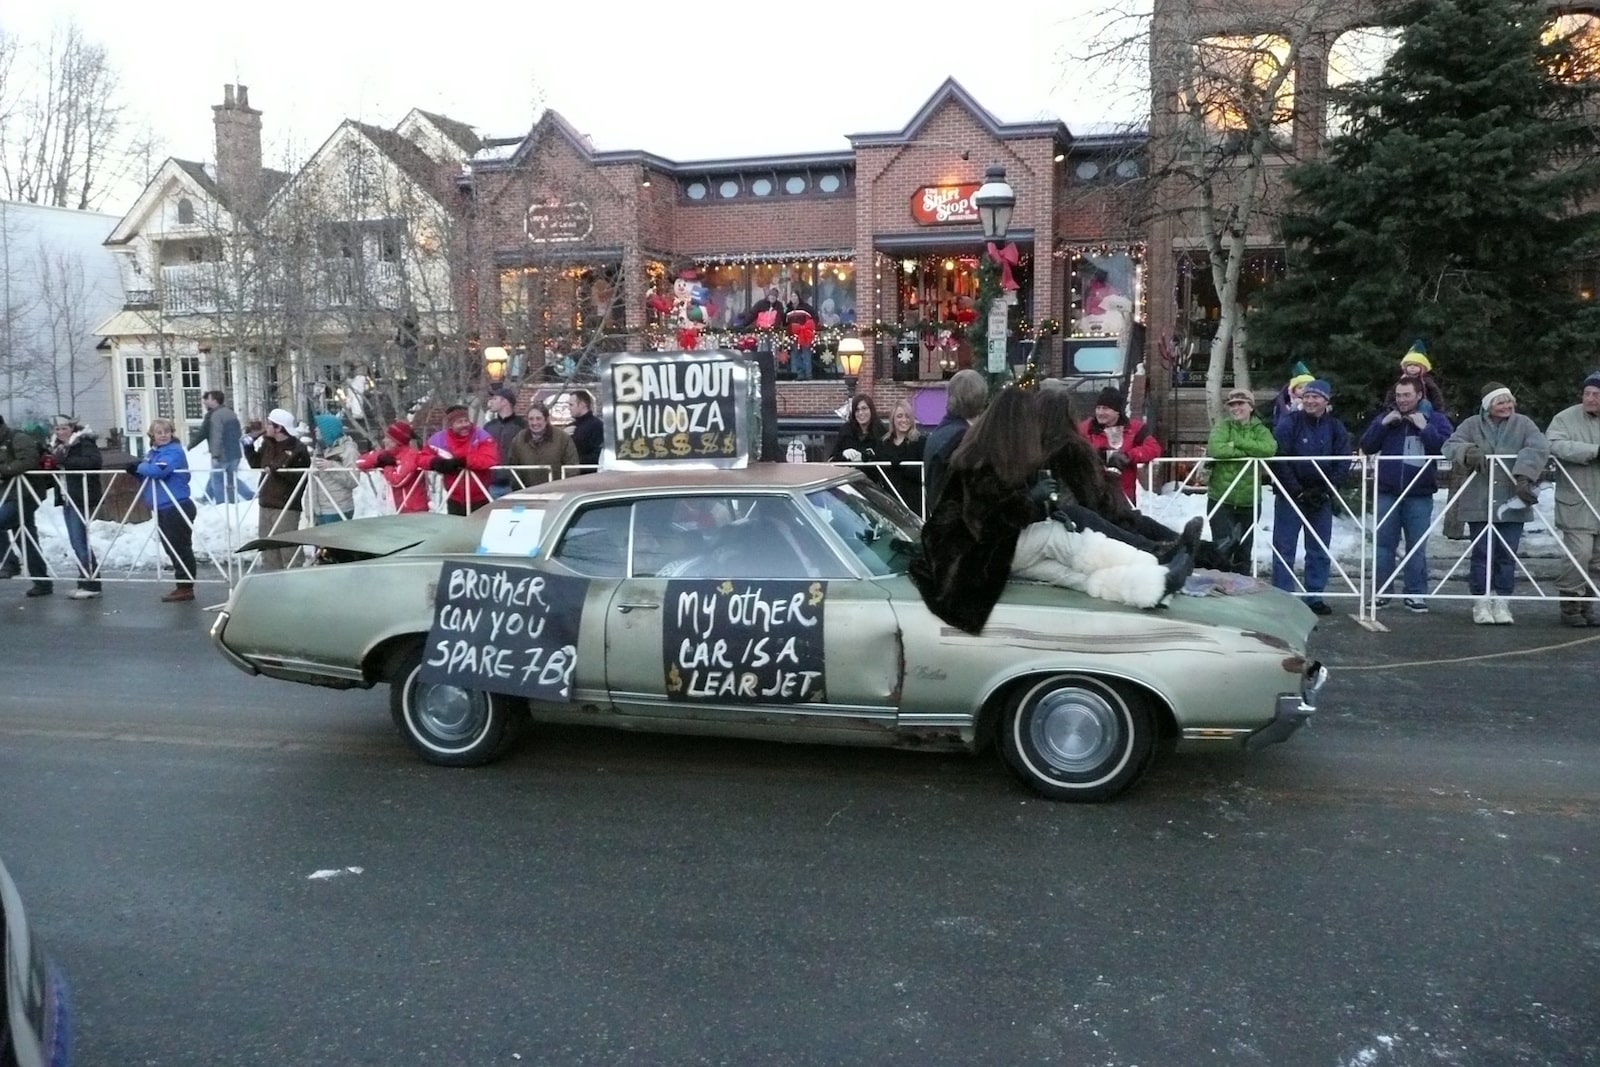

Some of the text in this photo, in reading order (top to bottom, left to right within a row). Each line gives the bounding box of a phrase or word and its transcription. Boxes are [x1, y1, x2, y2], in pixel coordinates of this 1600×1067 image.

[923, 187, 960, 212] Shirt
[936, 199, 968, 221] Stop
[613, 361, 735, 402] BAILOUT
[615, 400, 725, 442] PALLOOZA
[509, 520, 520, 536] 7
[440, 604, 546, 641] CAN YOU
[678, 591, 716, 639] My
[427, 640, 577, 697] SPARE 7B?
[679, 636, 799, 669] CAR IS A
[687, 670, 758, 697] LEAR
[762, 669, 822, 697] JET
